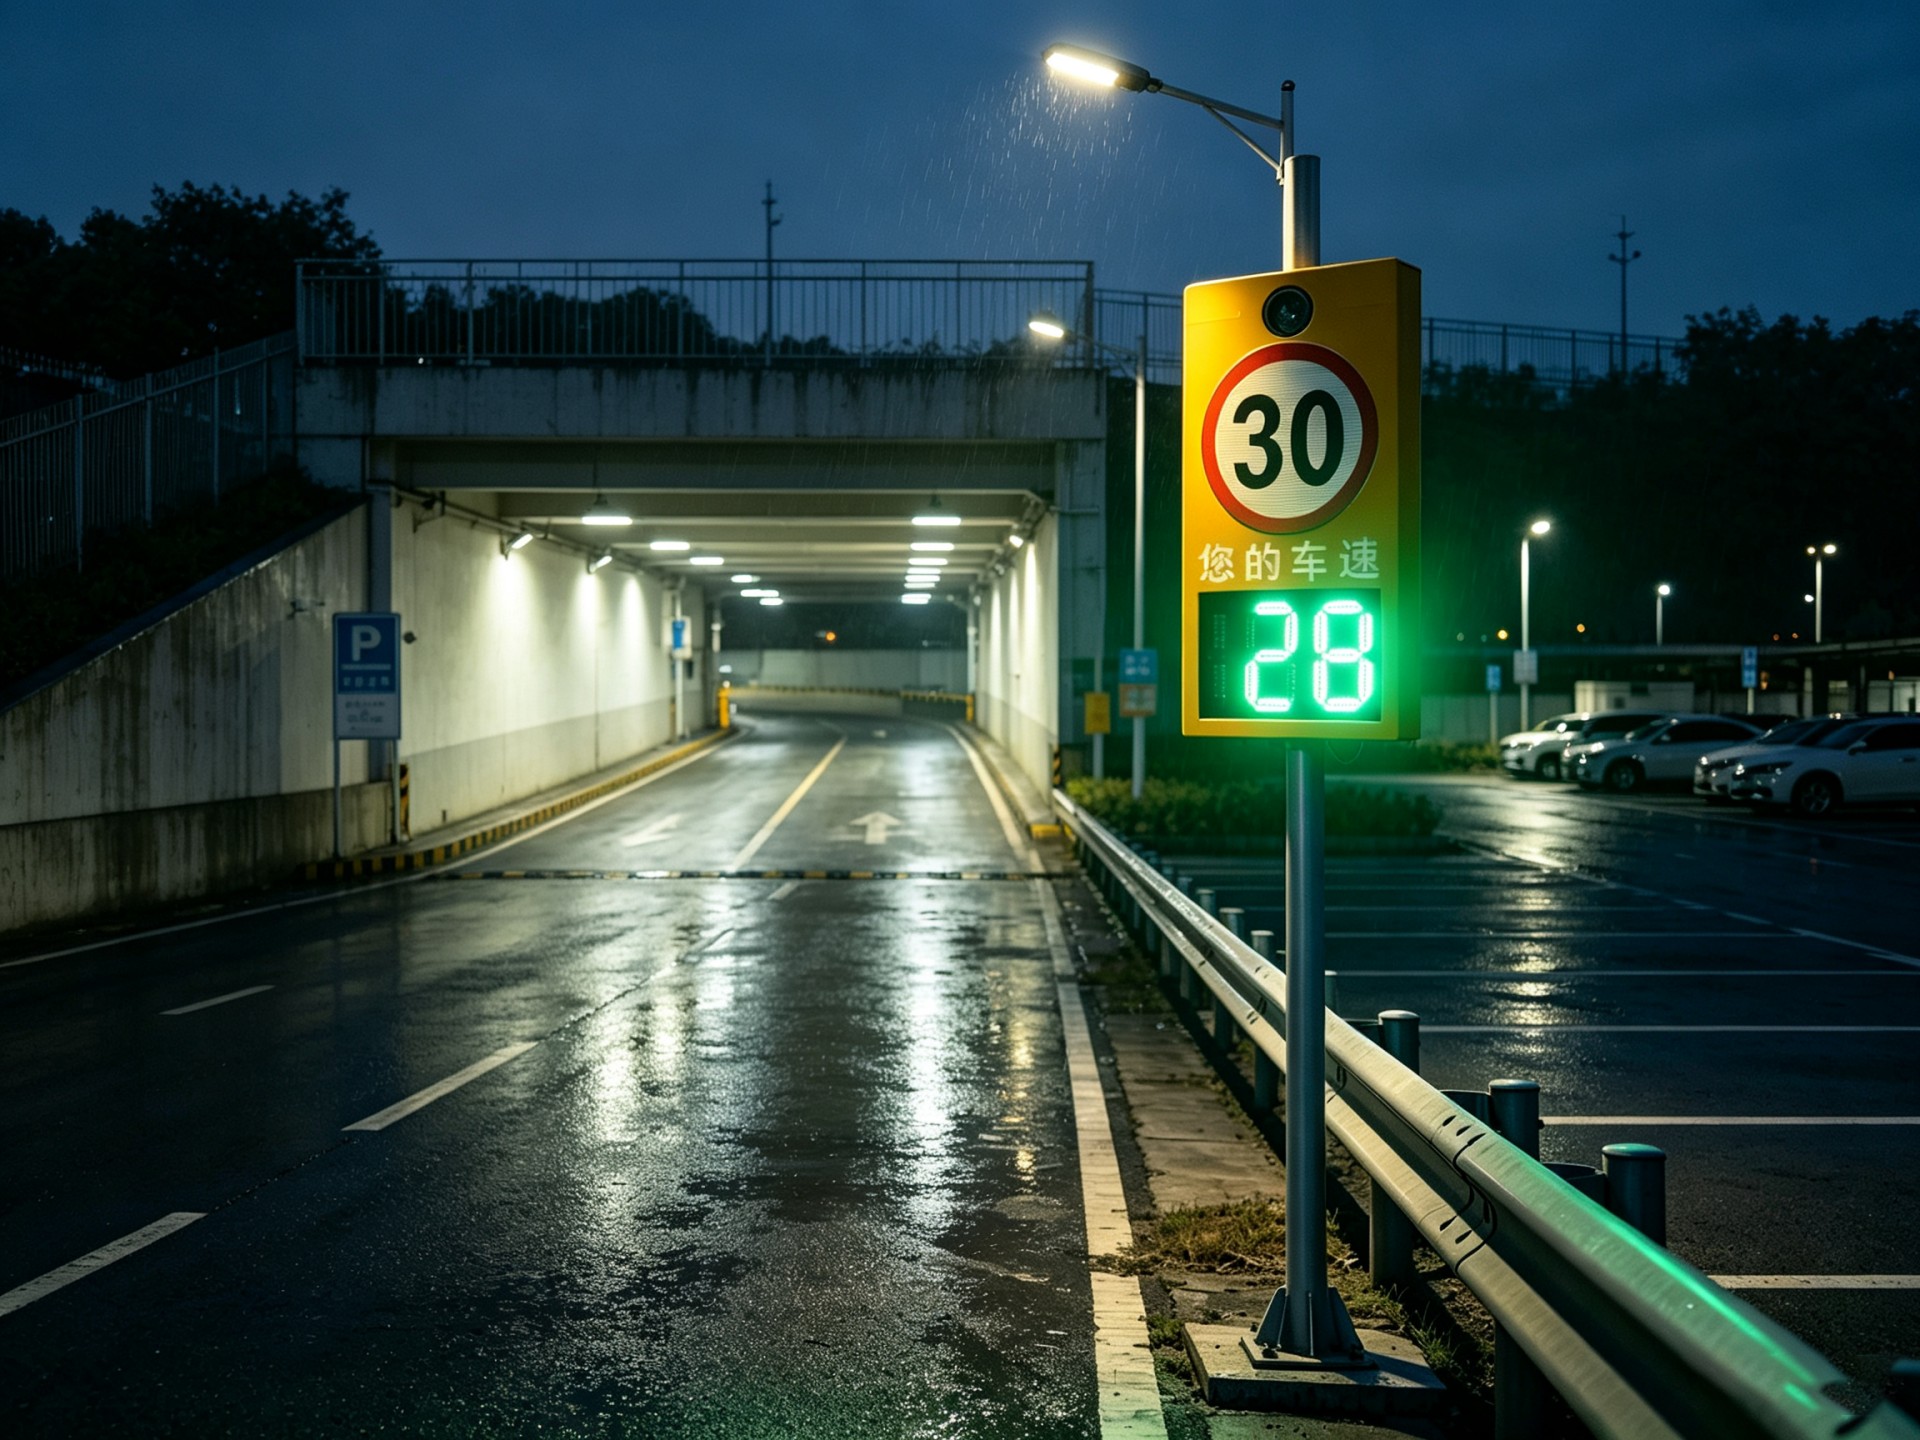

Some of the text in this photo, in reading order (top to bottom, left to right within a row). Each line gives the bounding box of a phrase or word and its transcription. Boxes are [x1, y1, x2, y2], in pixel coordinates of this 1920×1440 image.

[1233, 389, 1344, 490] 30
[1197, 536, 1381, 583] 您的车速
[352, 625, 382, 662] P
[1245, 600, 1374, 713] 28
